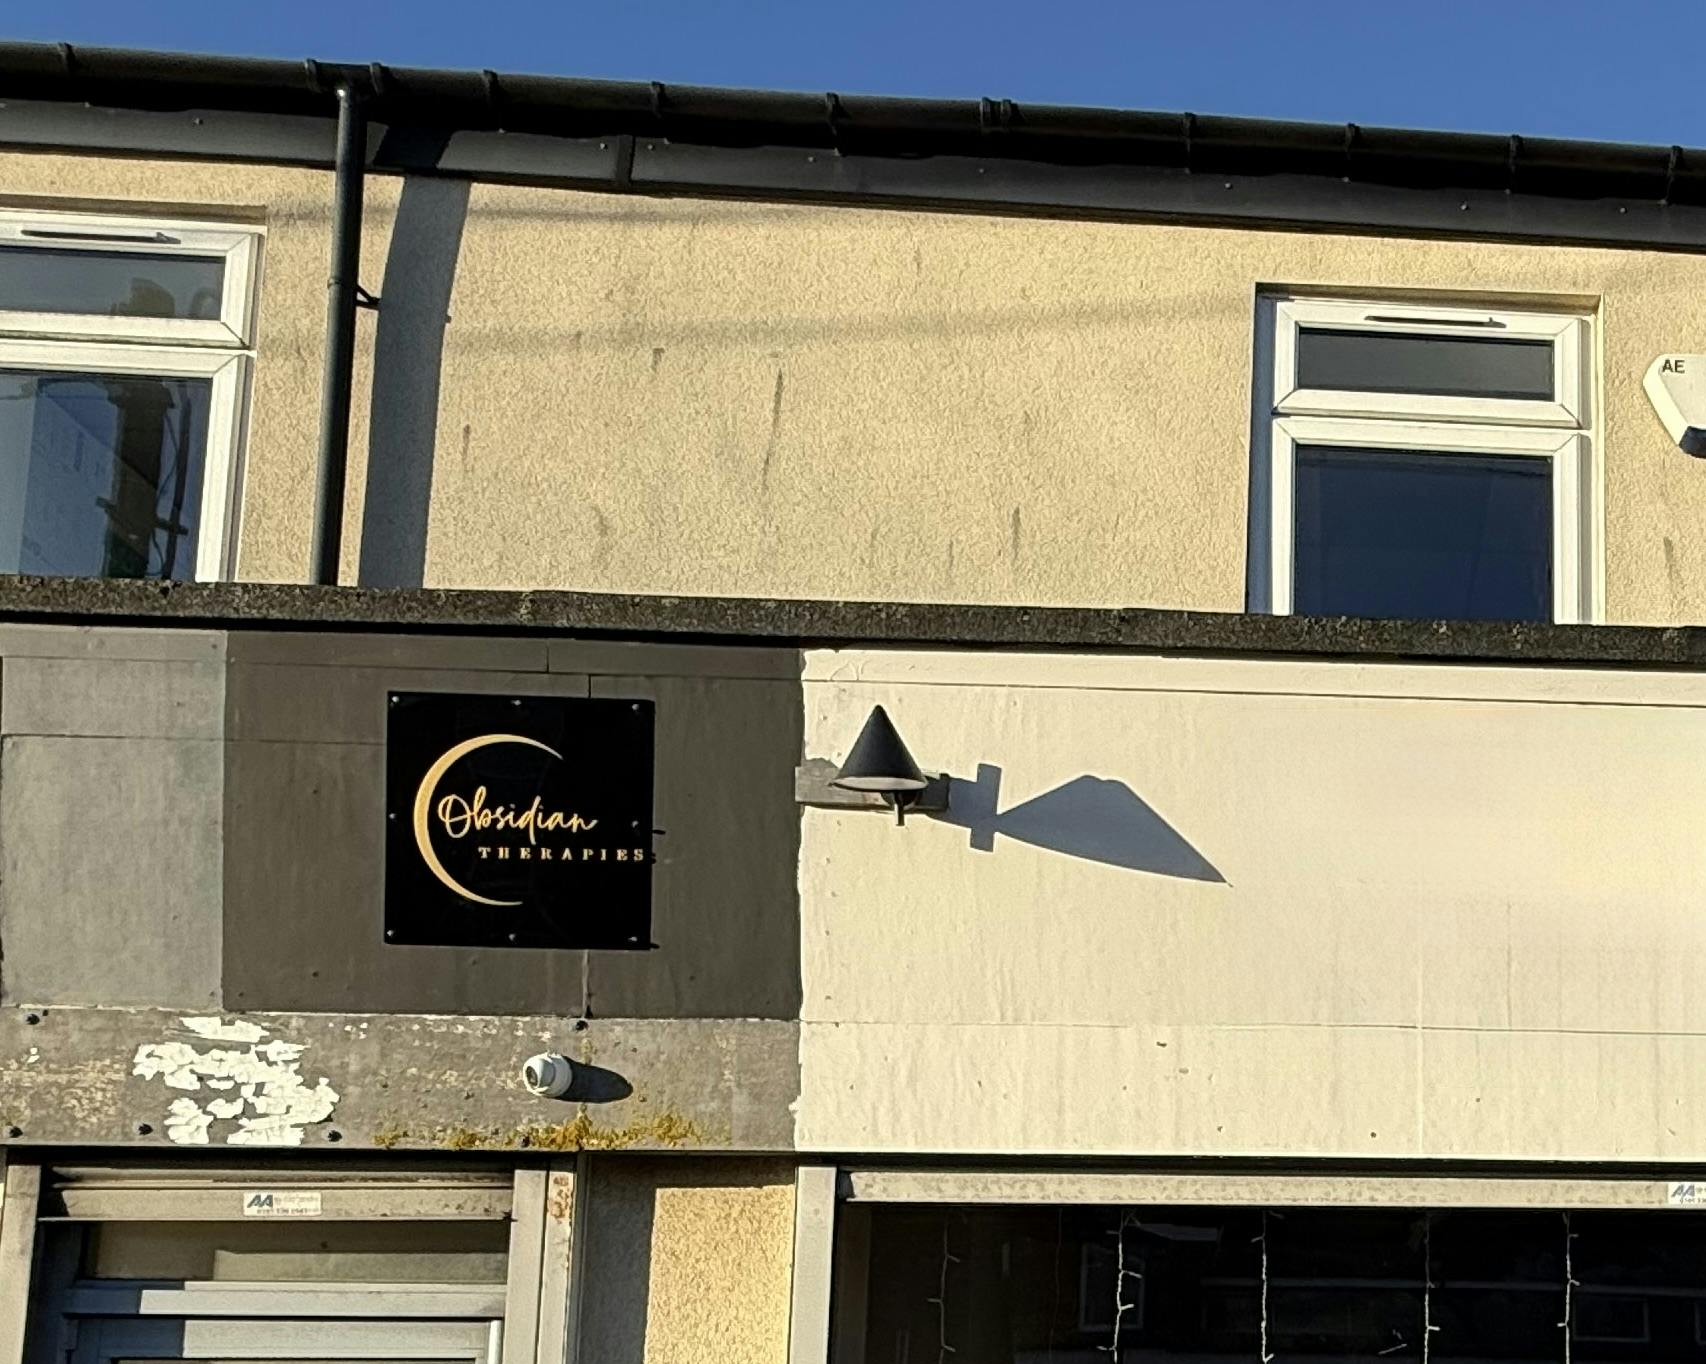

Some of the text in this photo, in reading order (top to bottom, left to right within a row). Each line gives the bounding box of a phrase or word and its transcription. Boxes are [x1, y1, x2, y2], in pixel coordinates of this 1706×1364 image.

[1661, 359, 1685, 374] AE
[438, 785, 598, 845] Obsidian
[477, 846, 645, 862] THERAPIES
